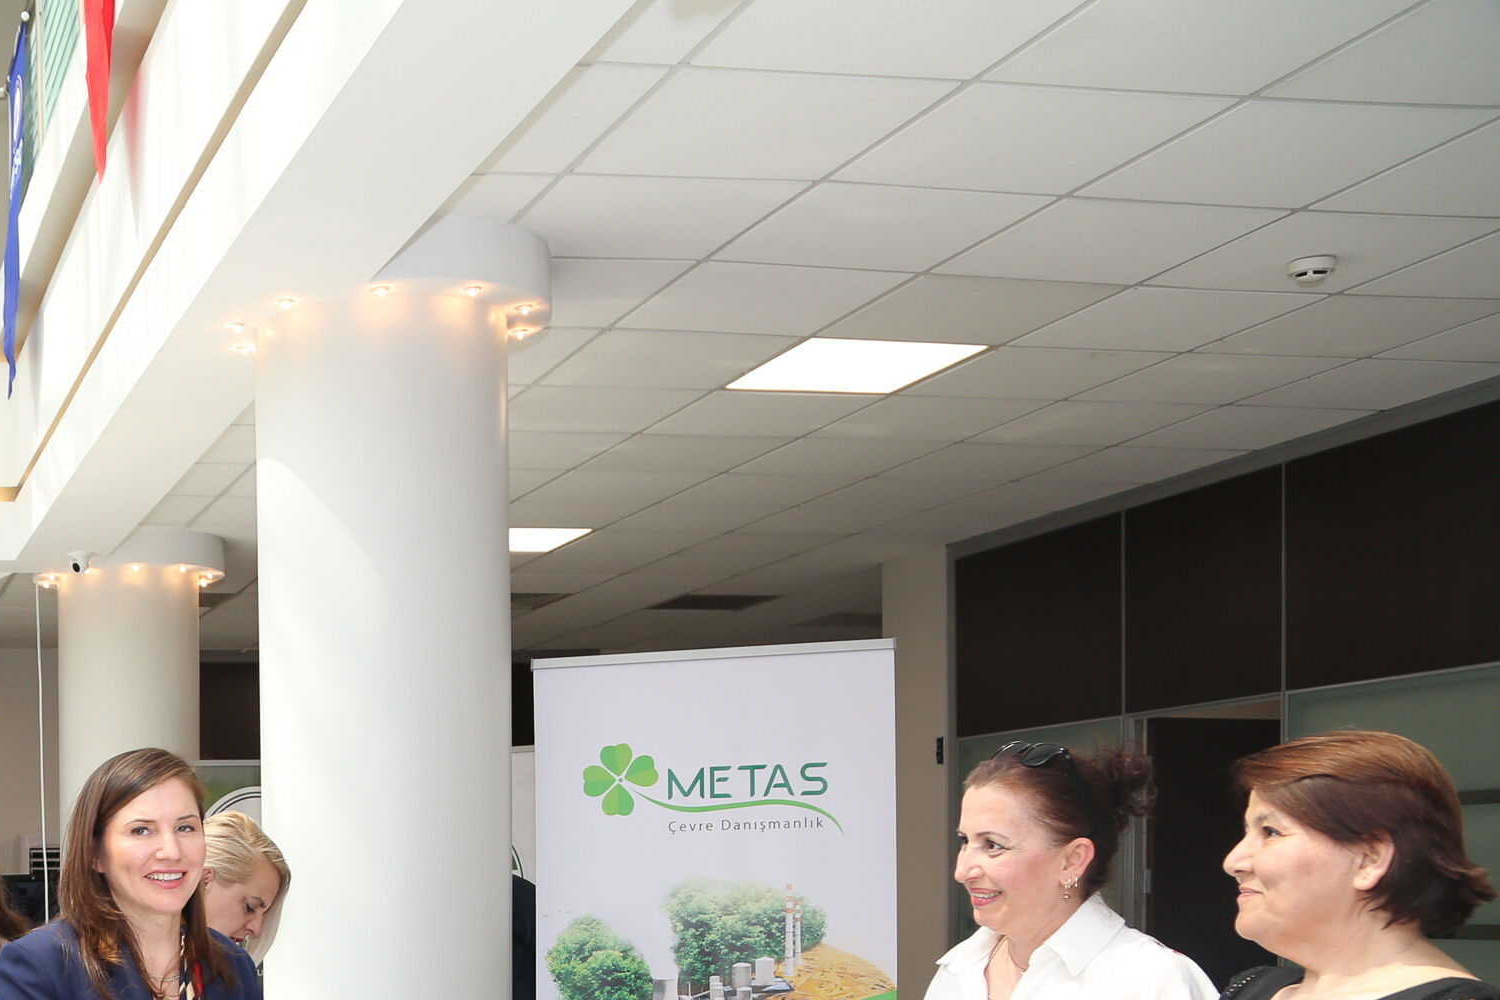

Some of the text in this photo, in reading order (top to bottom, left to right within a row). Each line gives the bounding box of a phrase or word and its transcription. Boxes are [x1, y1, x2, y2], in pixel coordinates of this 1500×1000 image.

[667, 762, 828, 800] METAS
[668, 816, 824, 835] Çevre Danışmanlık
